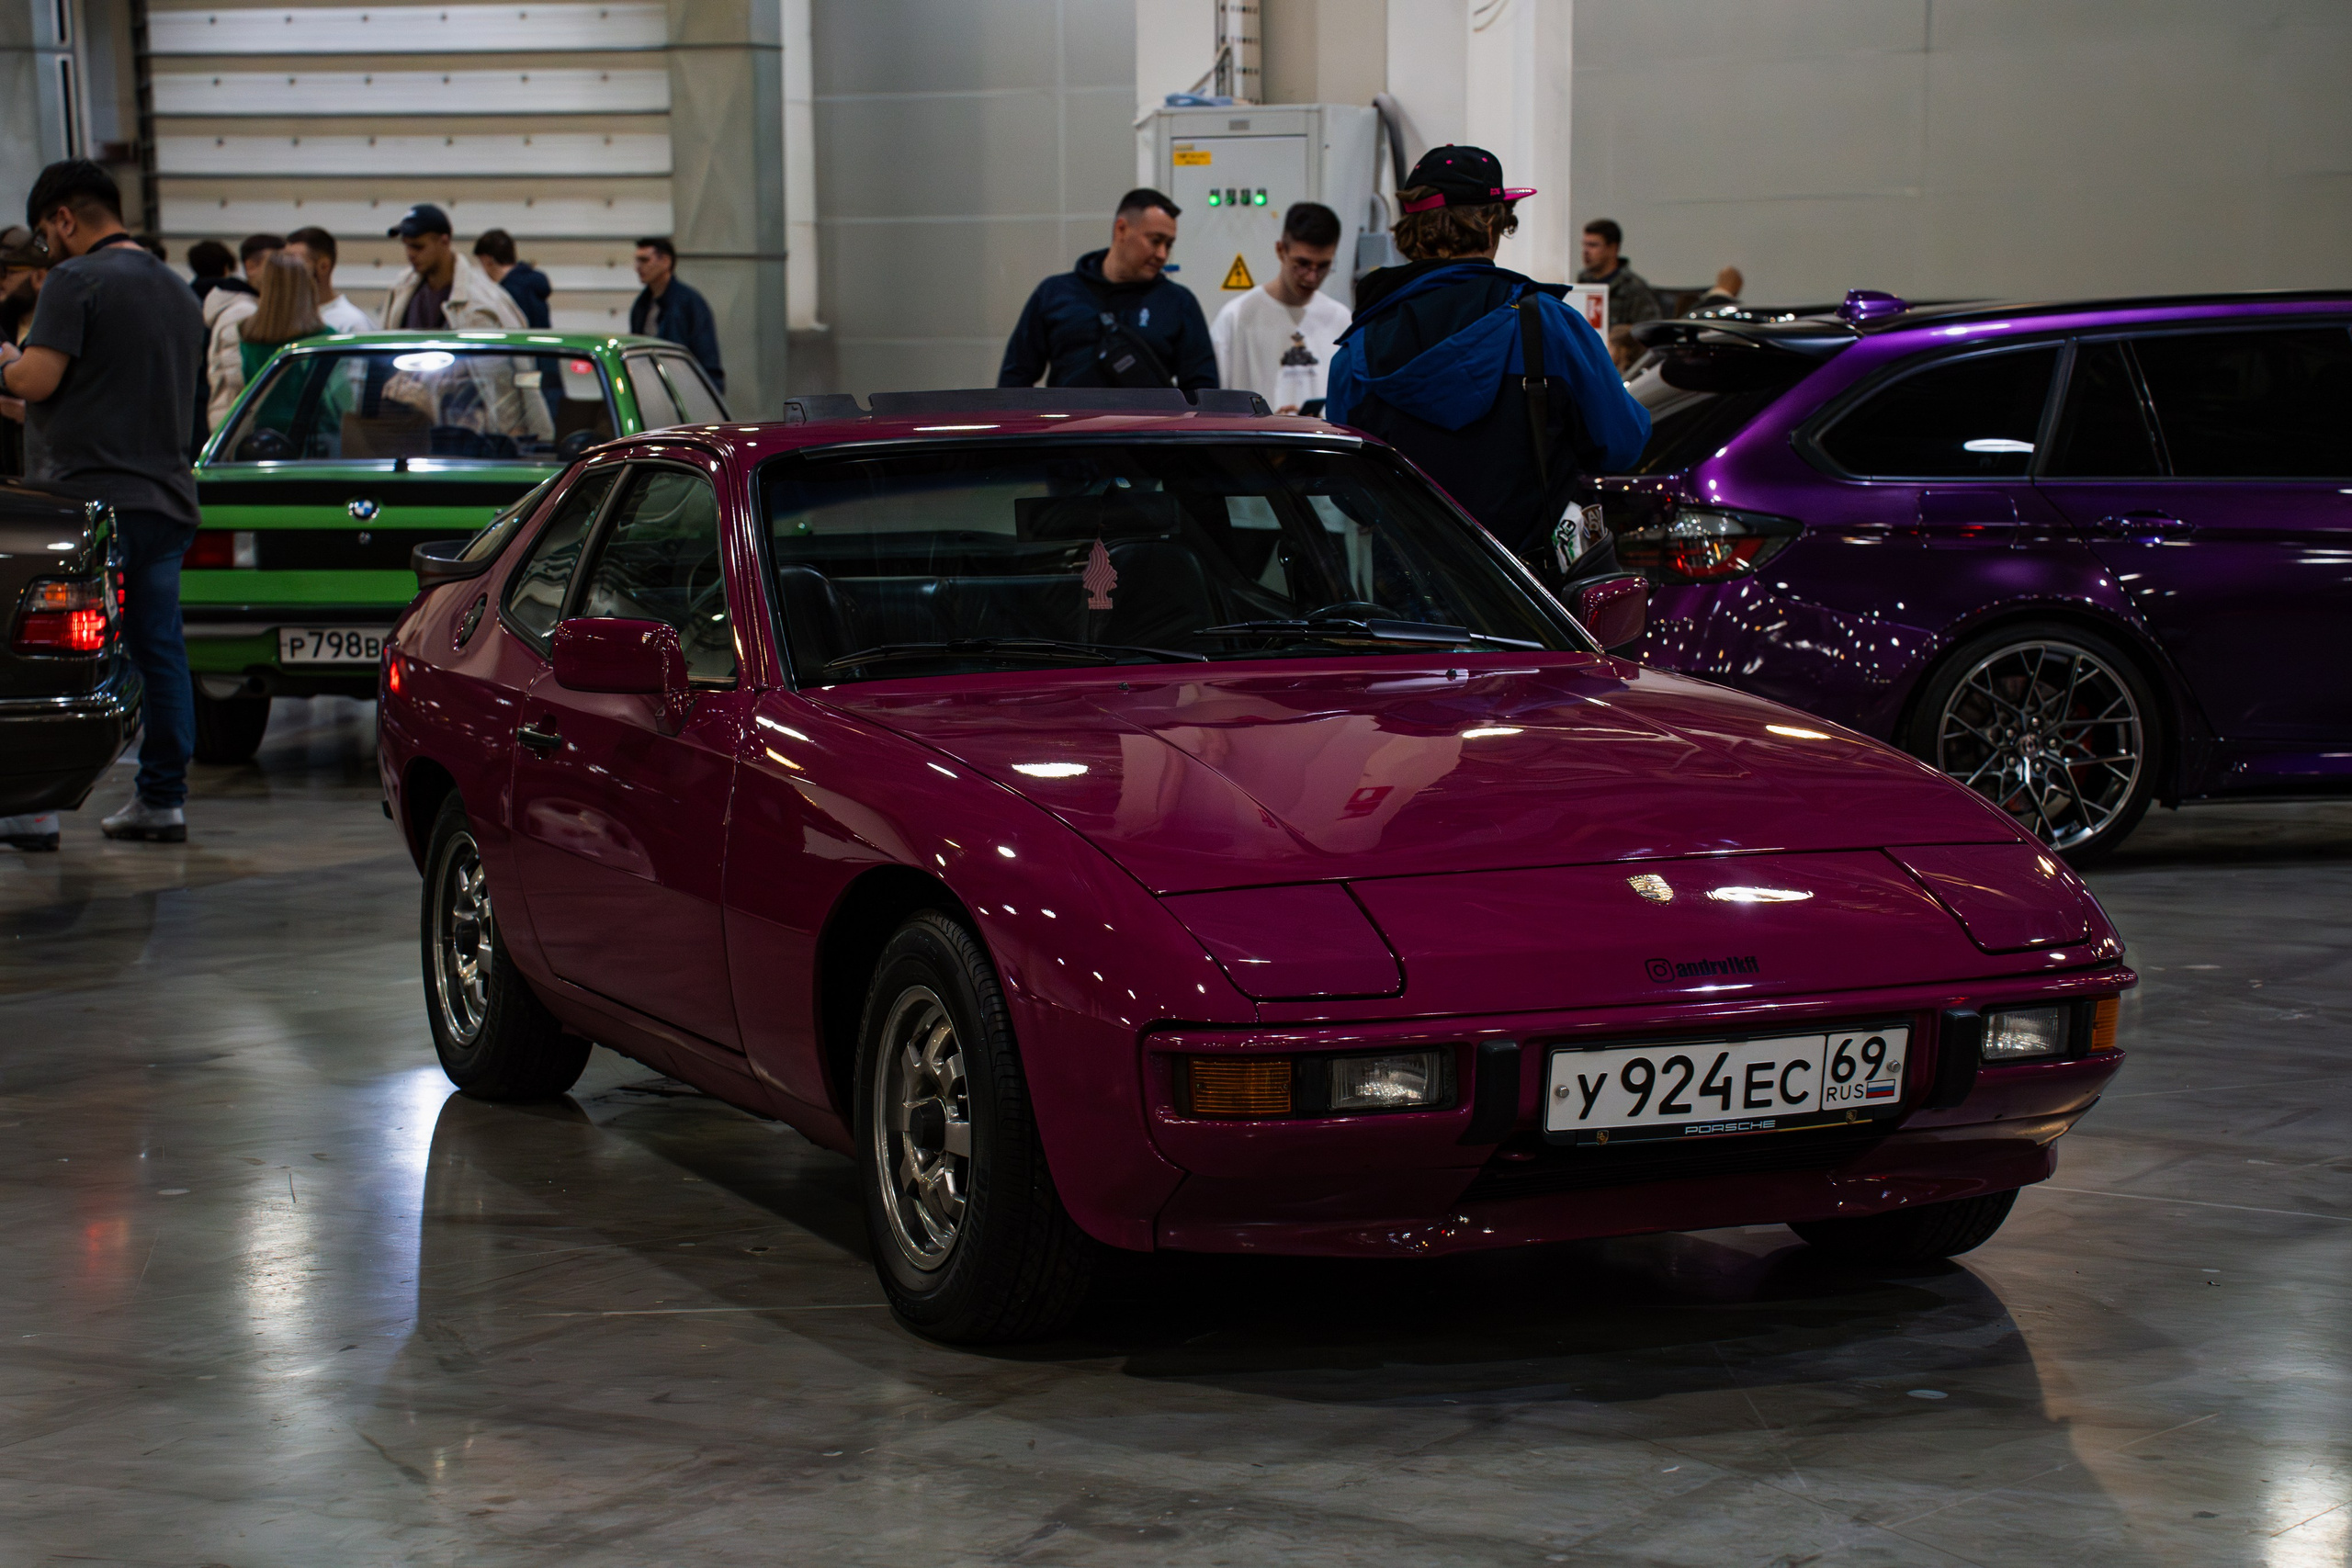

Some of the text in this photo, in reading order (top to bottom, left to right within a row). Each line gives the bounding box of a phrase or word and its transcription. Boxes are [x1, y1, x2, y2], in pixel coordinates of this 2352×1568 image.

[1831, 1036, 1886, 1083] 69
[1826, 1083, 1863, 1102] RUS
[1685, 1120, 1776, 1134] PORSCHE
